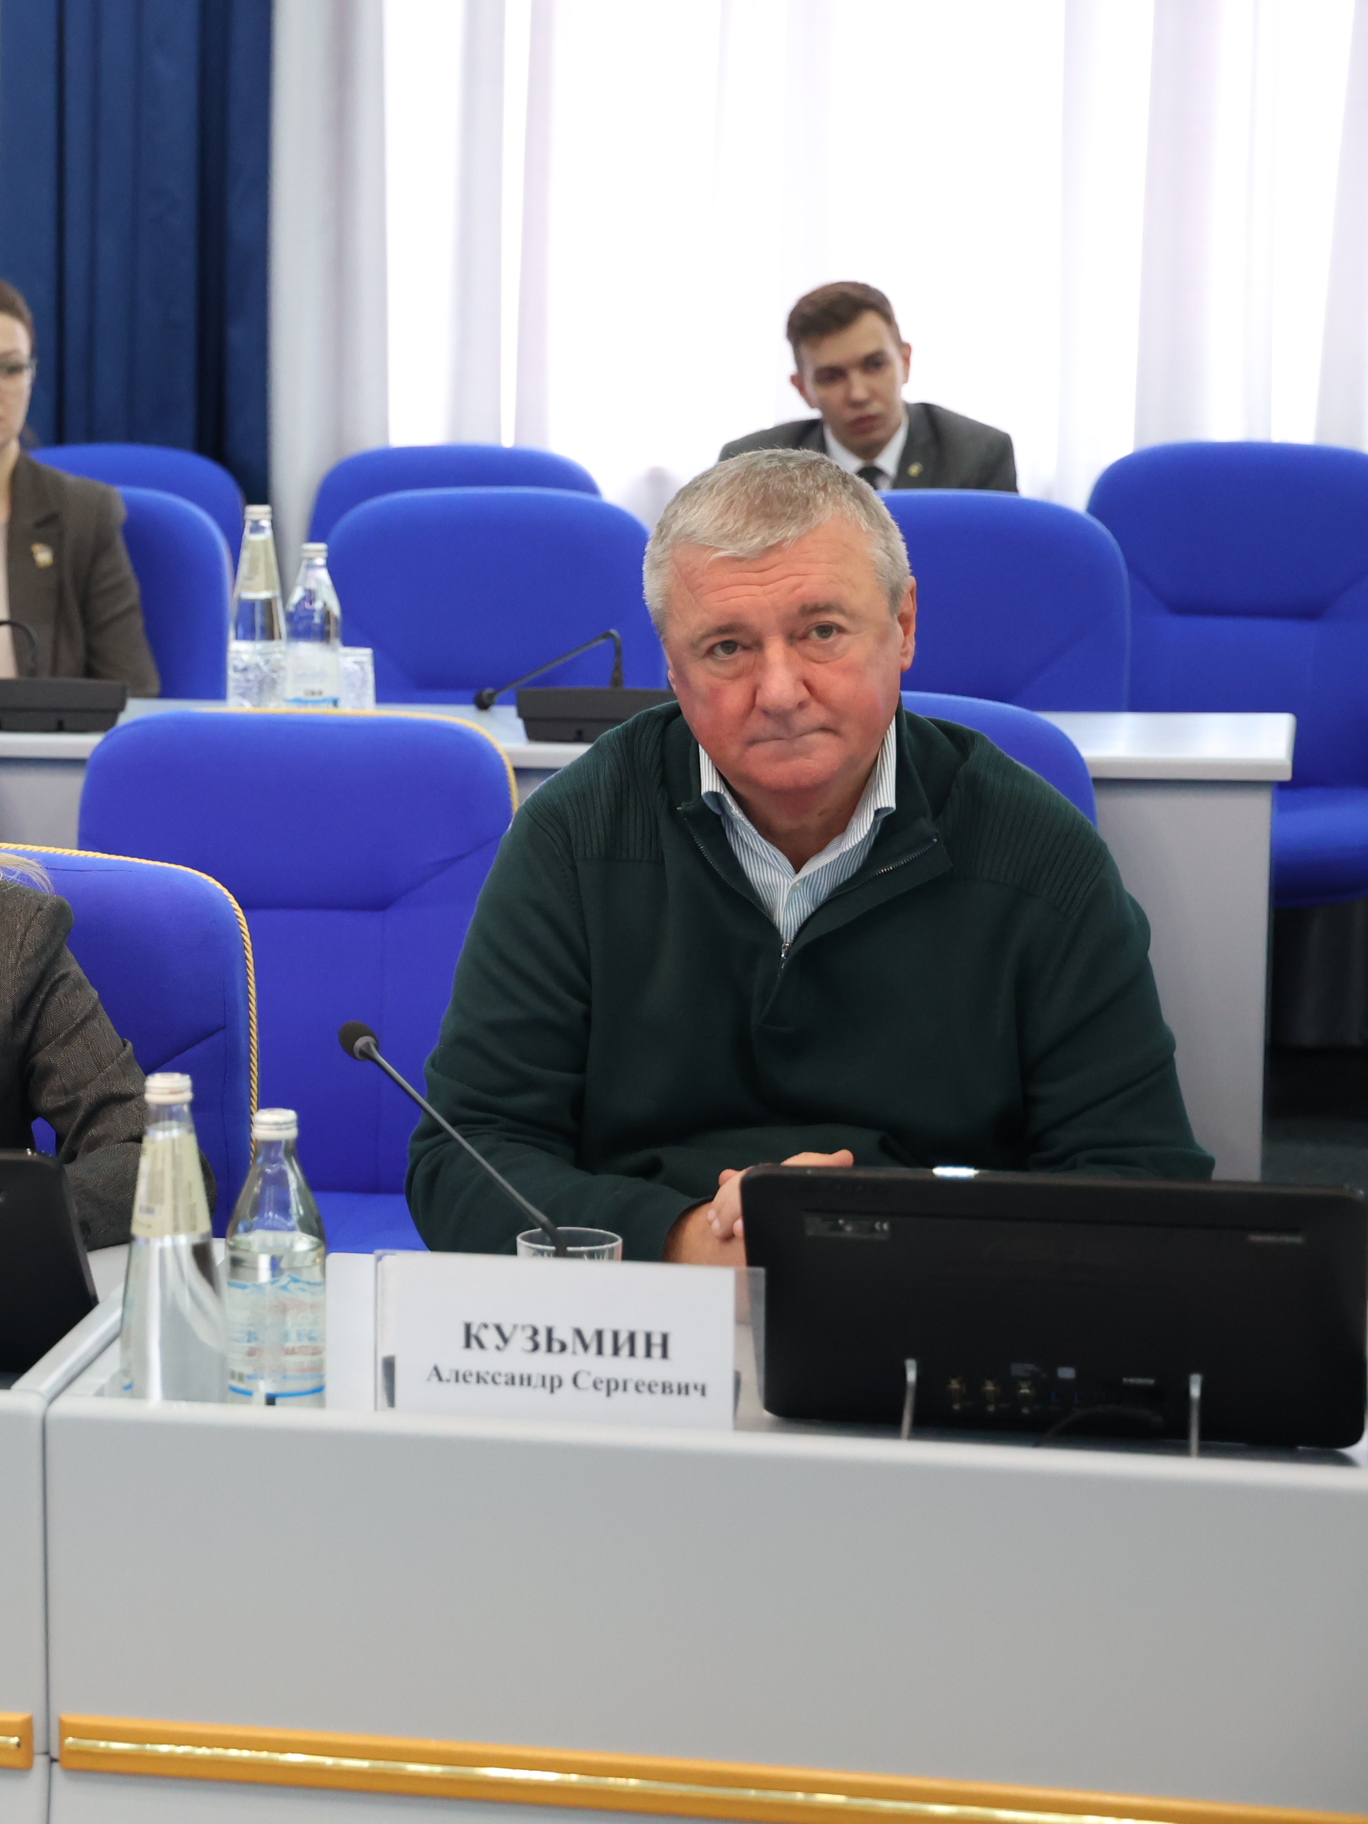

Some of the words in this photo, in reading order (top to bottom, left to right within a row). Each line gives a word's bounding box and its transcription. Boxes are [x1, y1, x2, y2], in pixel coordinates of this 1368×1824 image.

[463, 1321, 670, 1360] КУЗЬМИН
[427, 1364, 564, 1394] Александр
[571, 1370, 707, 1398] Сергеевич
